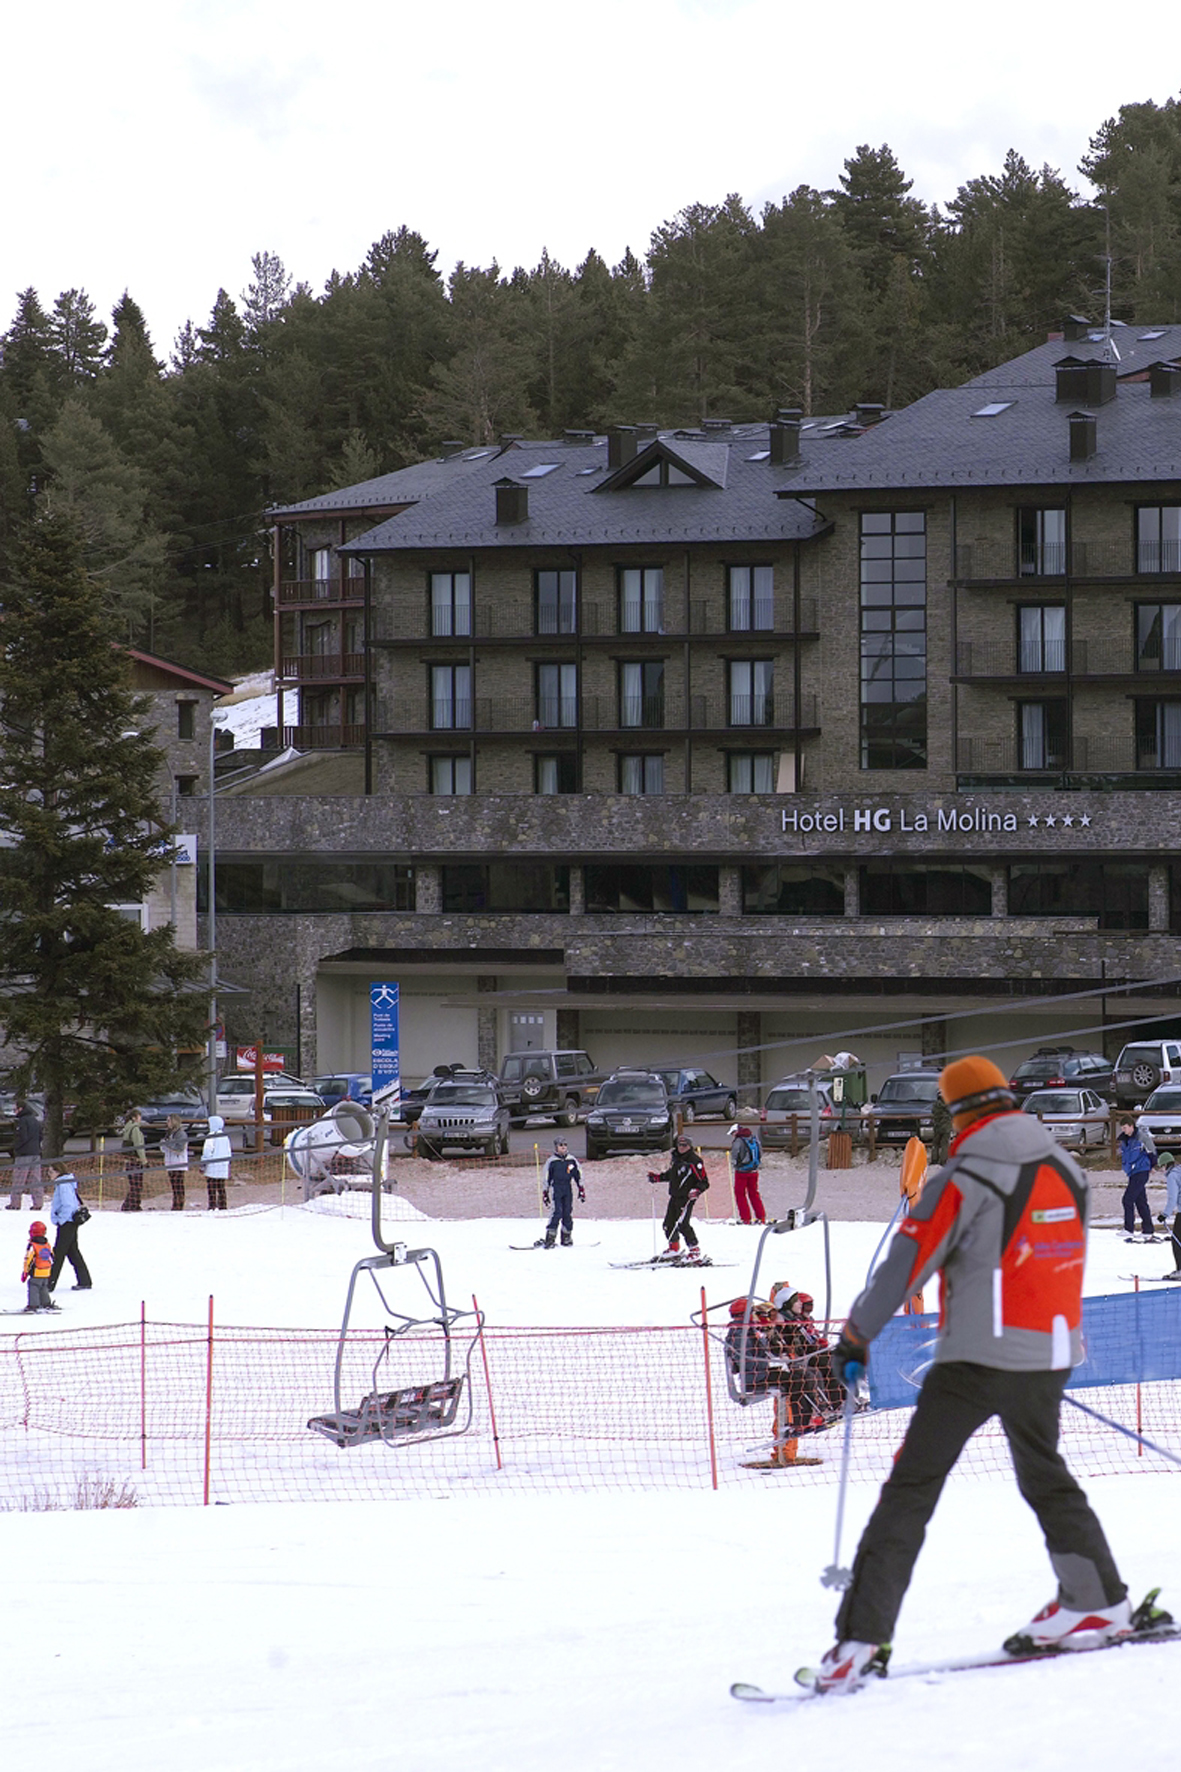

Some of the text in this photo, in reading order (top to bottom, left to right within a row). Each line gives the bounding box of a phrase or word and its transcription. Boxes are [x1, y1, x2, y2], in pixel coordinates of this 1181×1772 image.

[781, 808, 1018, 832] Hotel HG La Molina
